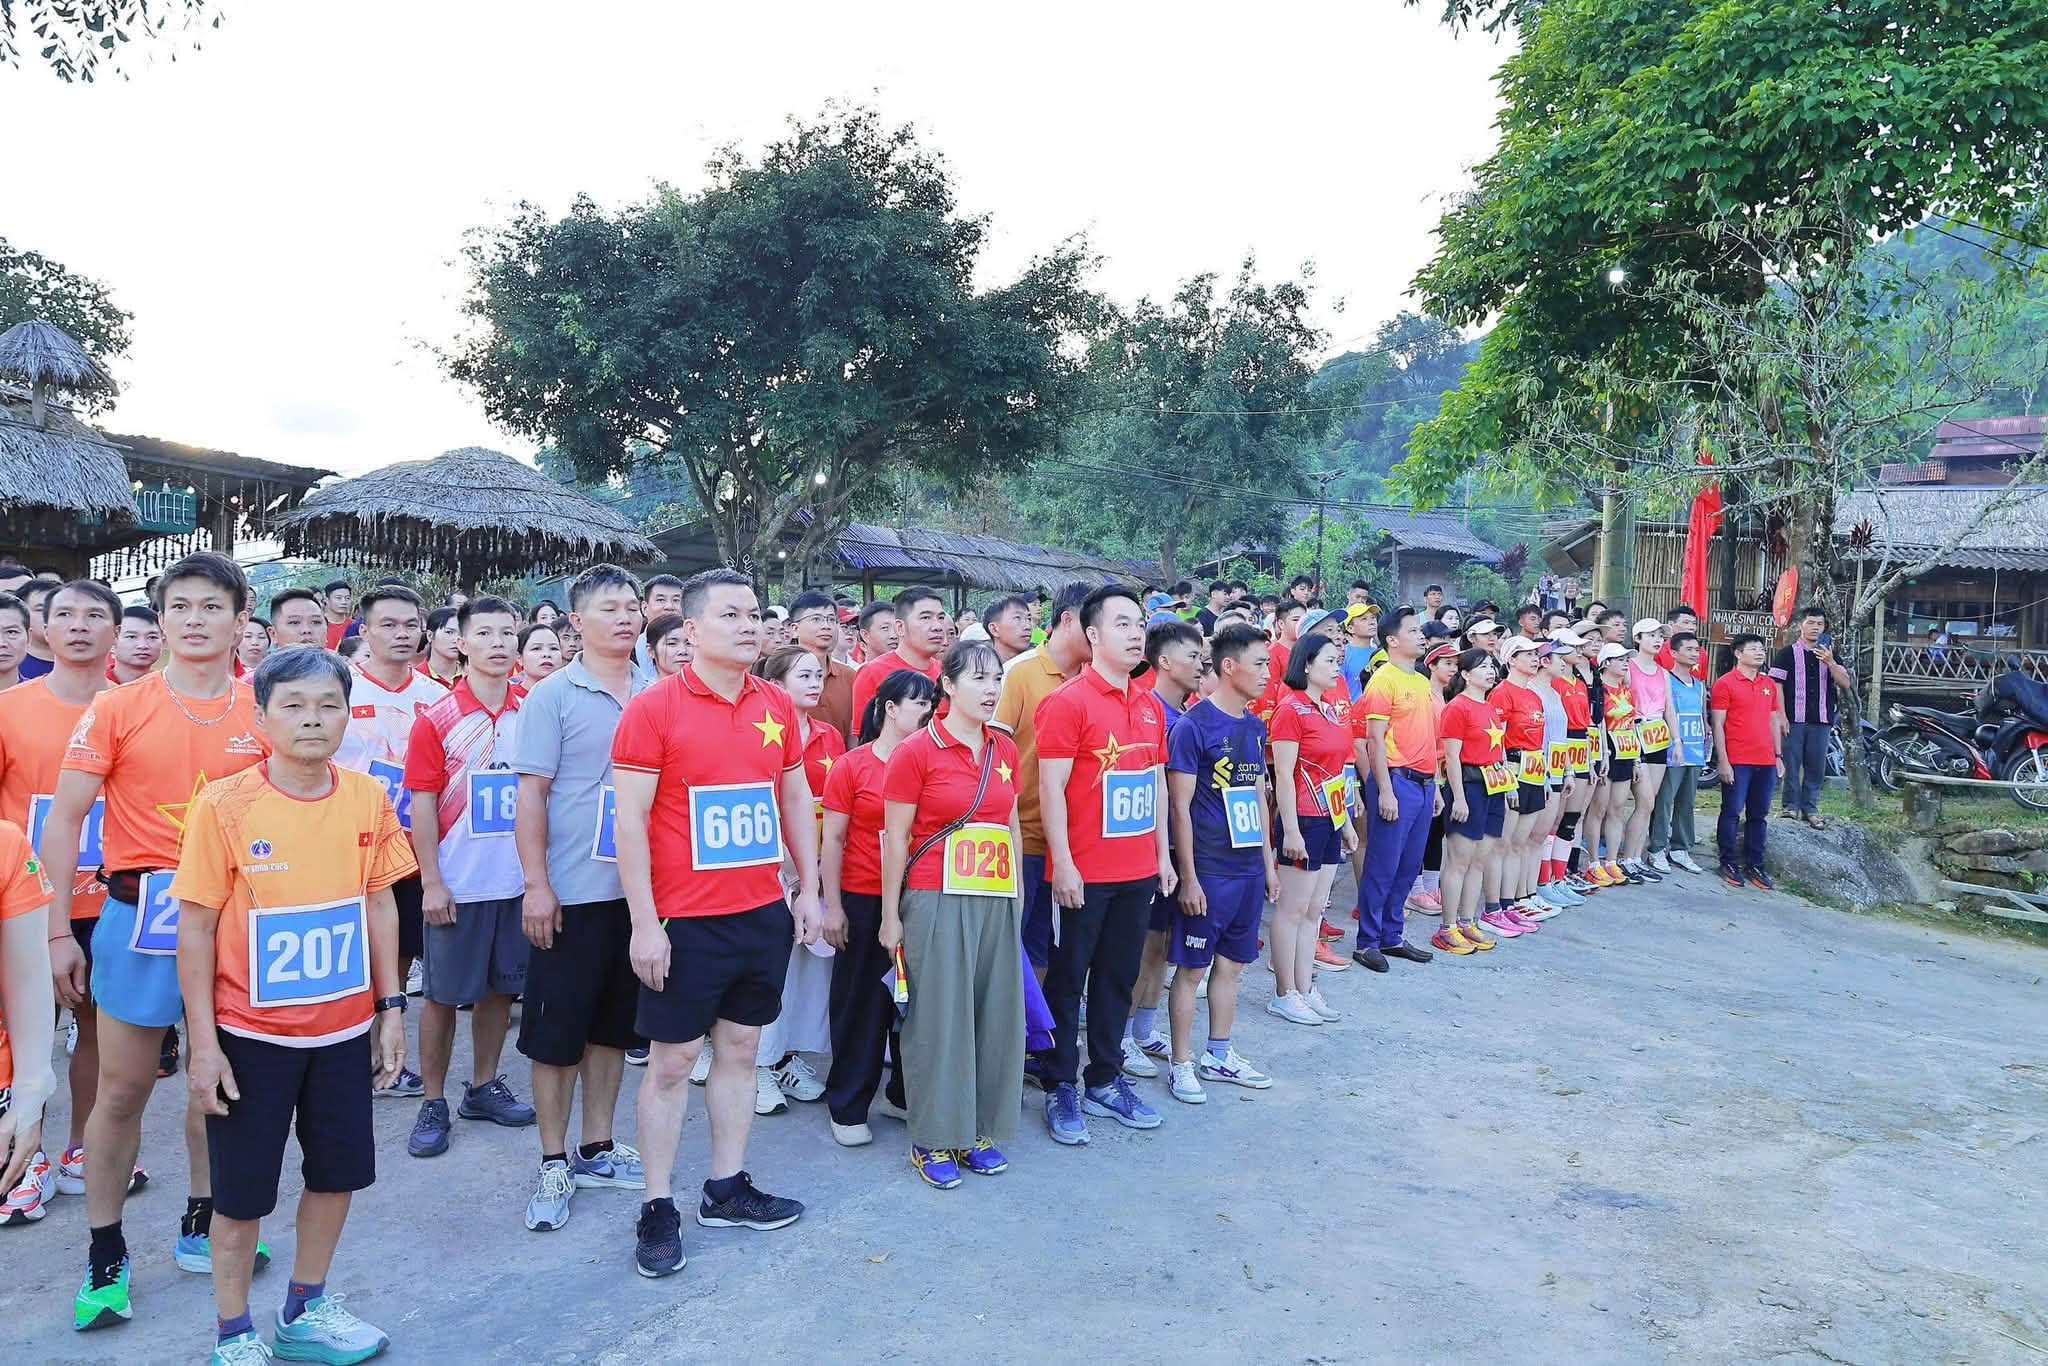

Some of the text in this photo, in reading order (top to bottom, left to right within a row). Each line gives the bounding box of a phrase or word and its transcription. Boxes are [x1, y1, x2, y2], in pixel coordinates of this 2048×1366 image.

[144, 490, 191, 526] COFFEE
[1753, 626, 1779, 638] TOILET
[1643, 725, 1669, 746] 022
[477, 784, 518, 821] 18
[1112, 783, 1153, 822] 669
[703, 801, 773, 849] 666
[955, 839, 1011, 880] 028
[266, 920, 356, 985] 207
[1185, 934, 1207, 950] SPORT
